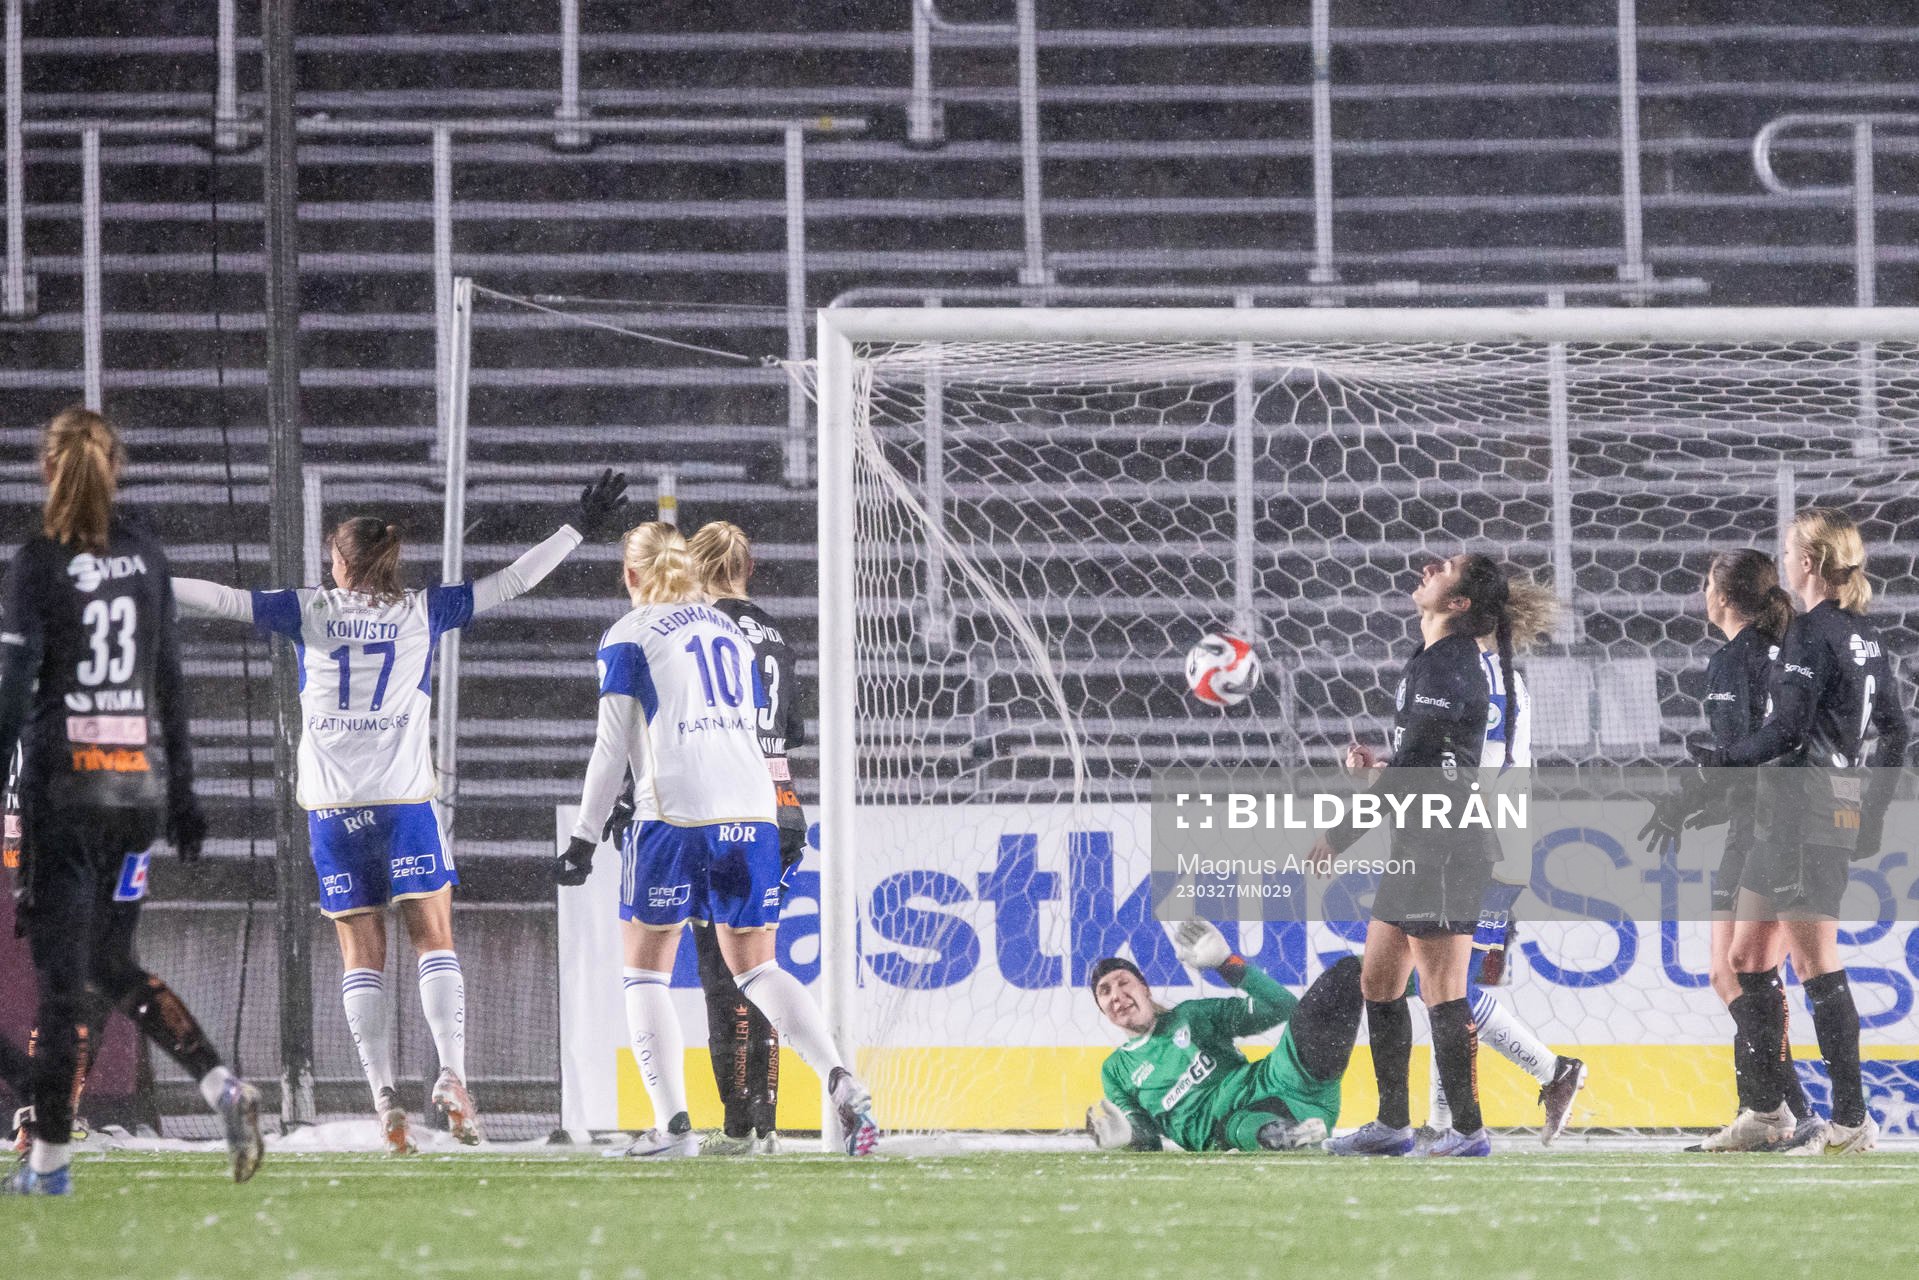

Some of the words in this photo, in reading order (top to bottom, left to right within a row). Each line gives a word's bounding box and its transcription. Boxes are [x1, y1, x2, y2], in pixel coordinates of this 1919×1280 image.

[327, 619, 398, 639] KOIVISTO
[757, 622, 786, 646] VIDA
[77, 596, 136, 686] 33
[330, 640, 395, 711] 17
[685, 635, 744, 707] 10
[1415, 694, 1452, 709] Scandic
[1708, 692, 1736, 702] candic
[718, 822, 756, 842] RÖR
[391, 856, 414, 869] pre
[393, 866, 425, 879] zero
[649, 886, 673, 897] pre
[649, 897, 682, 907] zero
[1508, 1039, 1539, 1068] Ocab
[1189, 1048, 1216, 1081] GO
